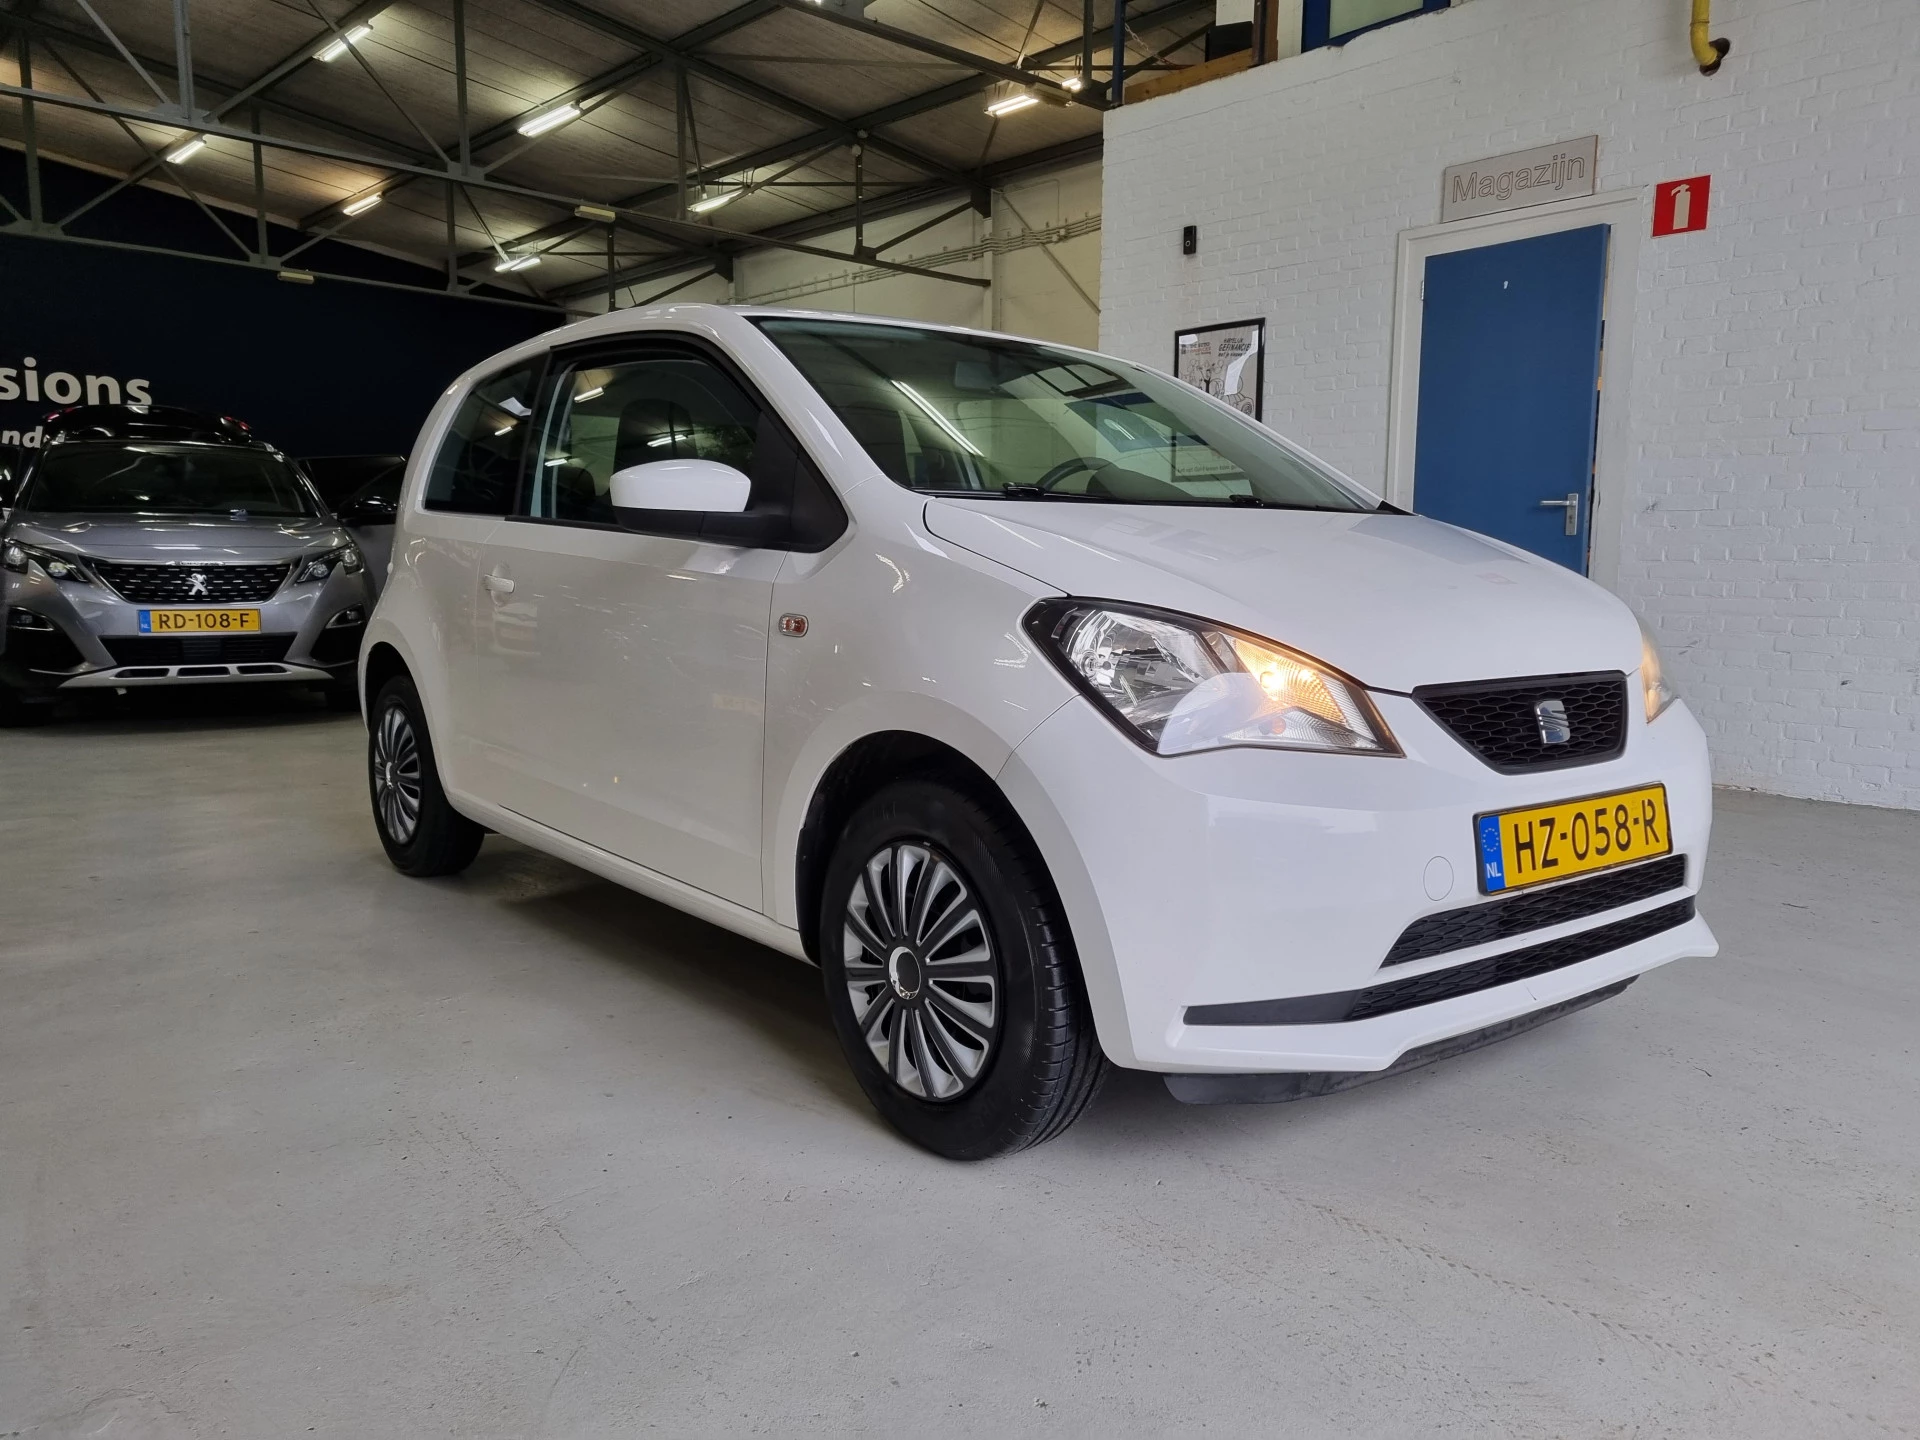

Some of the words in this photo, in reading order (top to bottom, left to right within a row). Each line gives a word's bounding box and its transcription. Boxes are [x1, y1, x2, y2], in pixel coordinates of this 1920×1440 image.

[1451, 152, 1586, 203] Magazijn
[0, 356, 153, 405] sions
[157, 613, 250, 629] RD-108-F
[1486, 863, 1502, 878] NL
[1513, 798, 1661, 874] HZ-058-R
